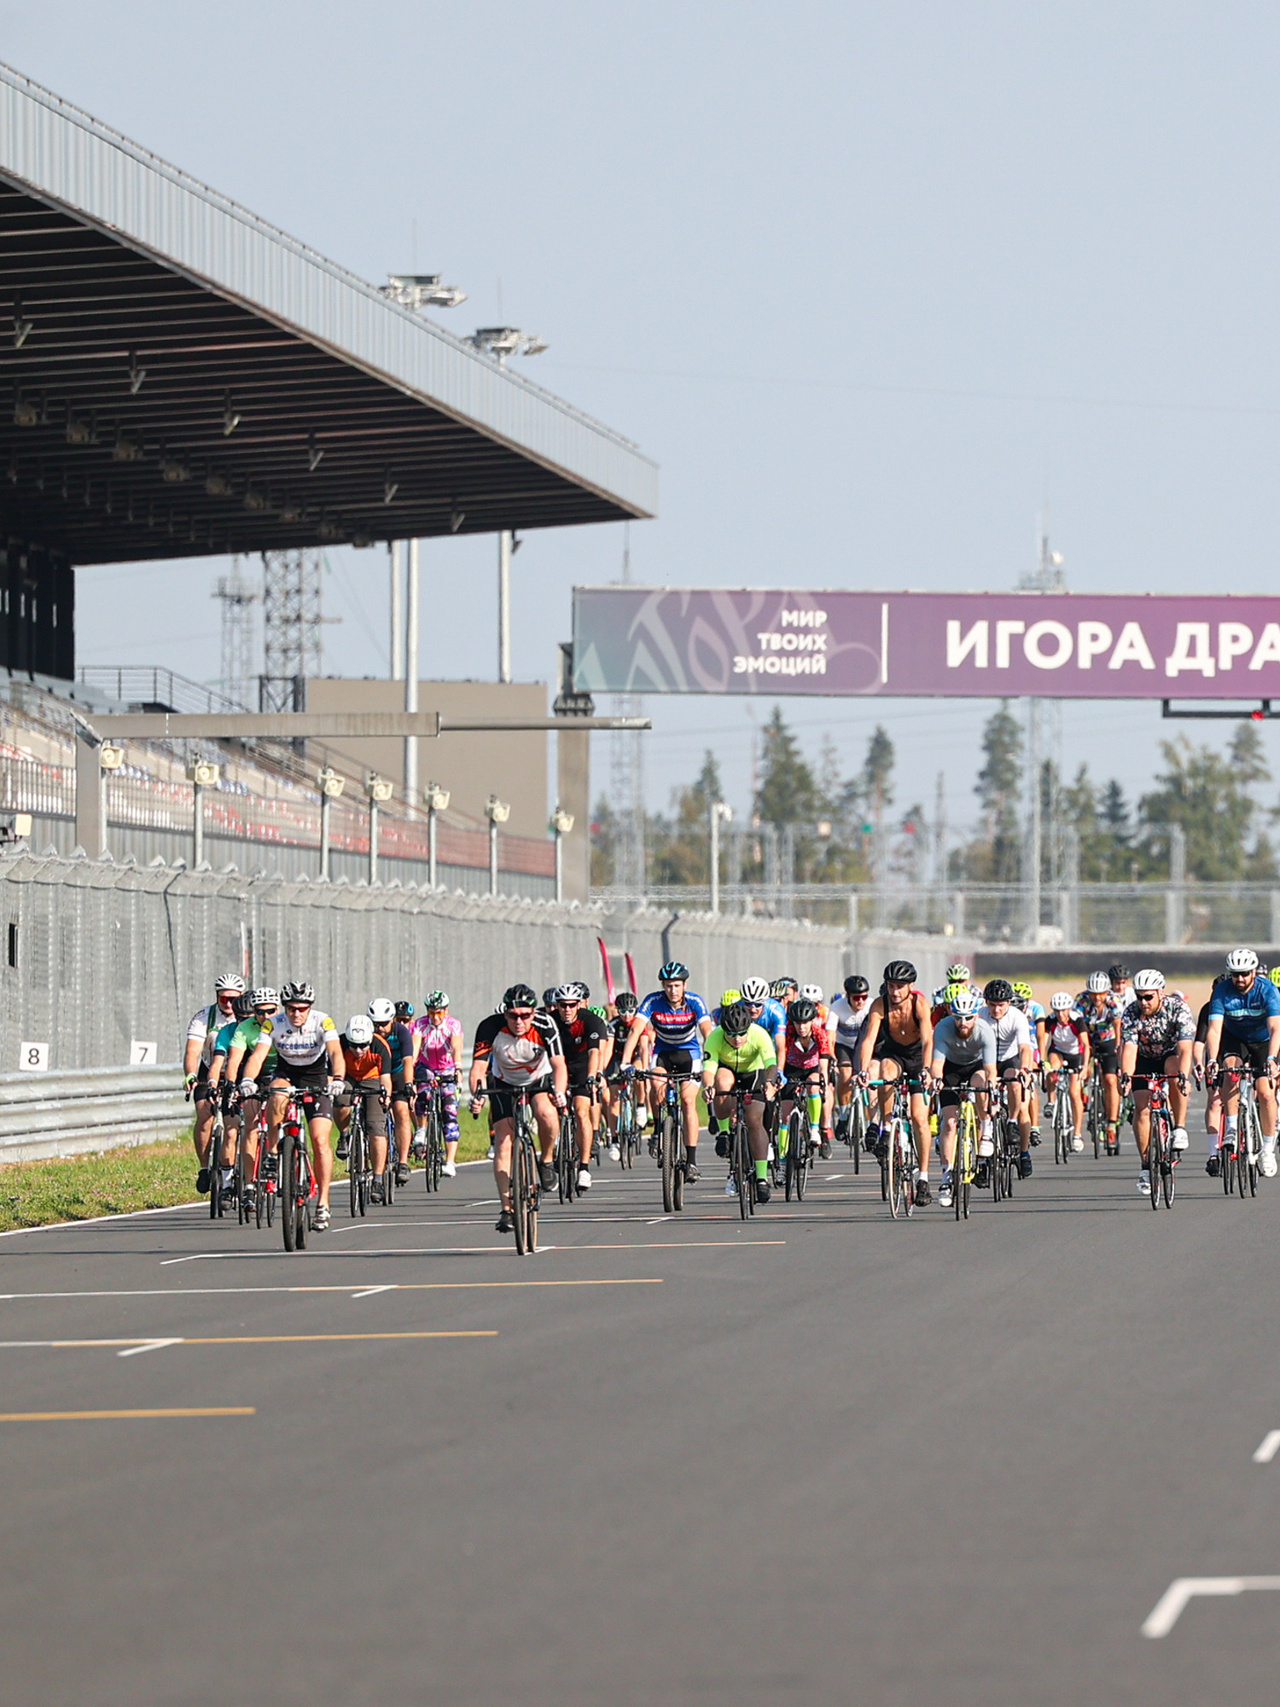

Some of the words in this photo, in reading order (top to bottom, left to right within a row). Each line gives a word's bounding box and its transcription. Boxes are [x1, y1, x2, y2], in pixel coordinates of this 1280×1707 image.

[781, 609, 828, 628] МИР
[757, 632, 828, 651] ТВОИХ
[946, 619, 1156, 670] ИГОРА
[733, 653, 827, 676] ЭМОЦИЙ
[28, 1047, 40, 1065] 8
[138, 1047, 148, 1062] 7
